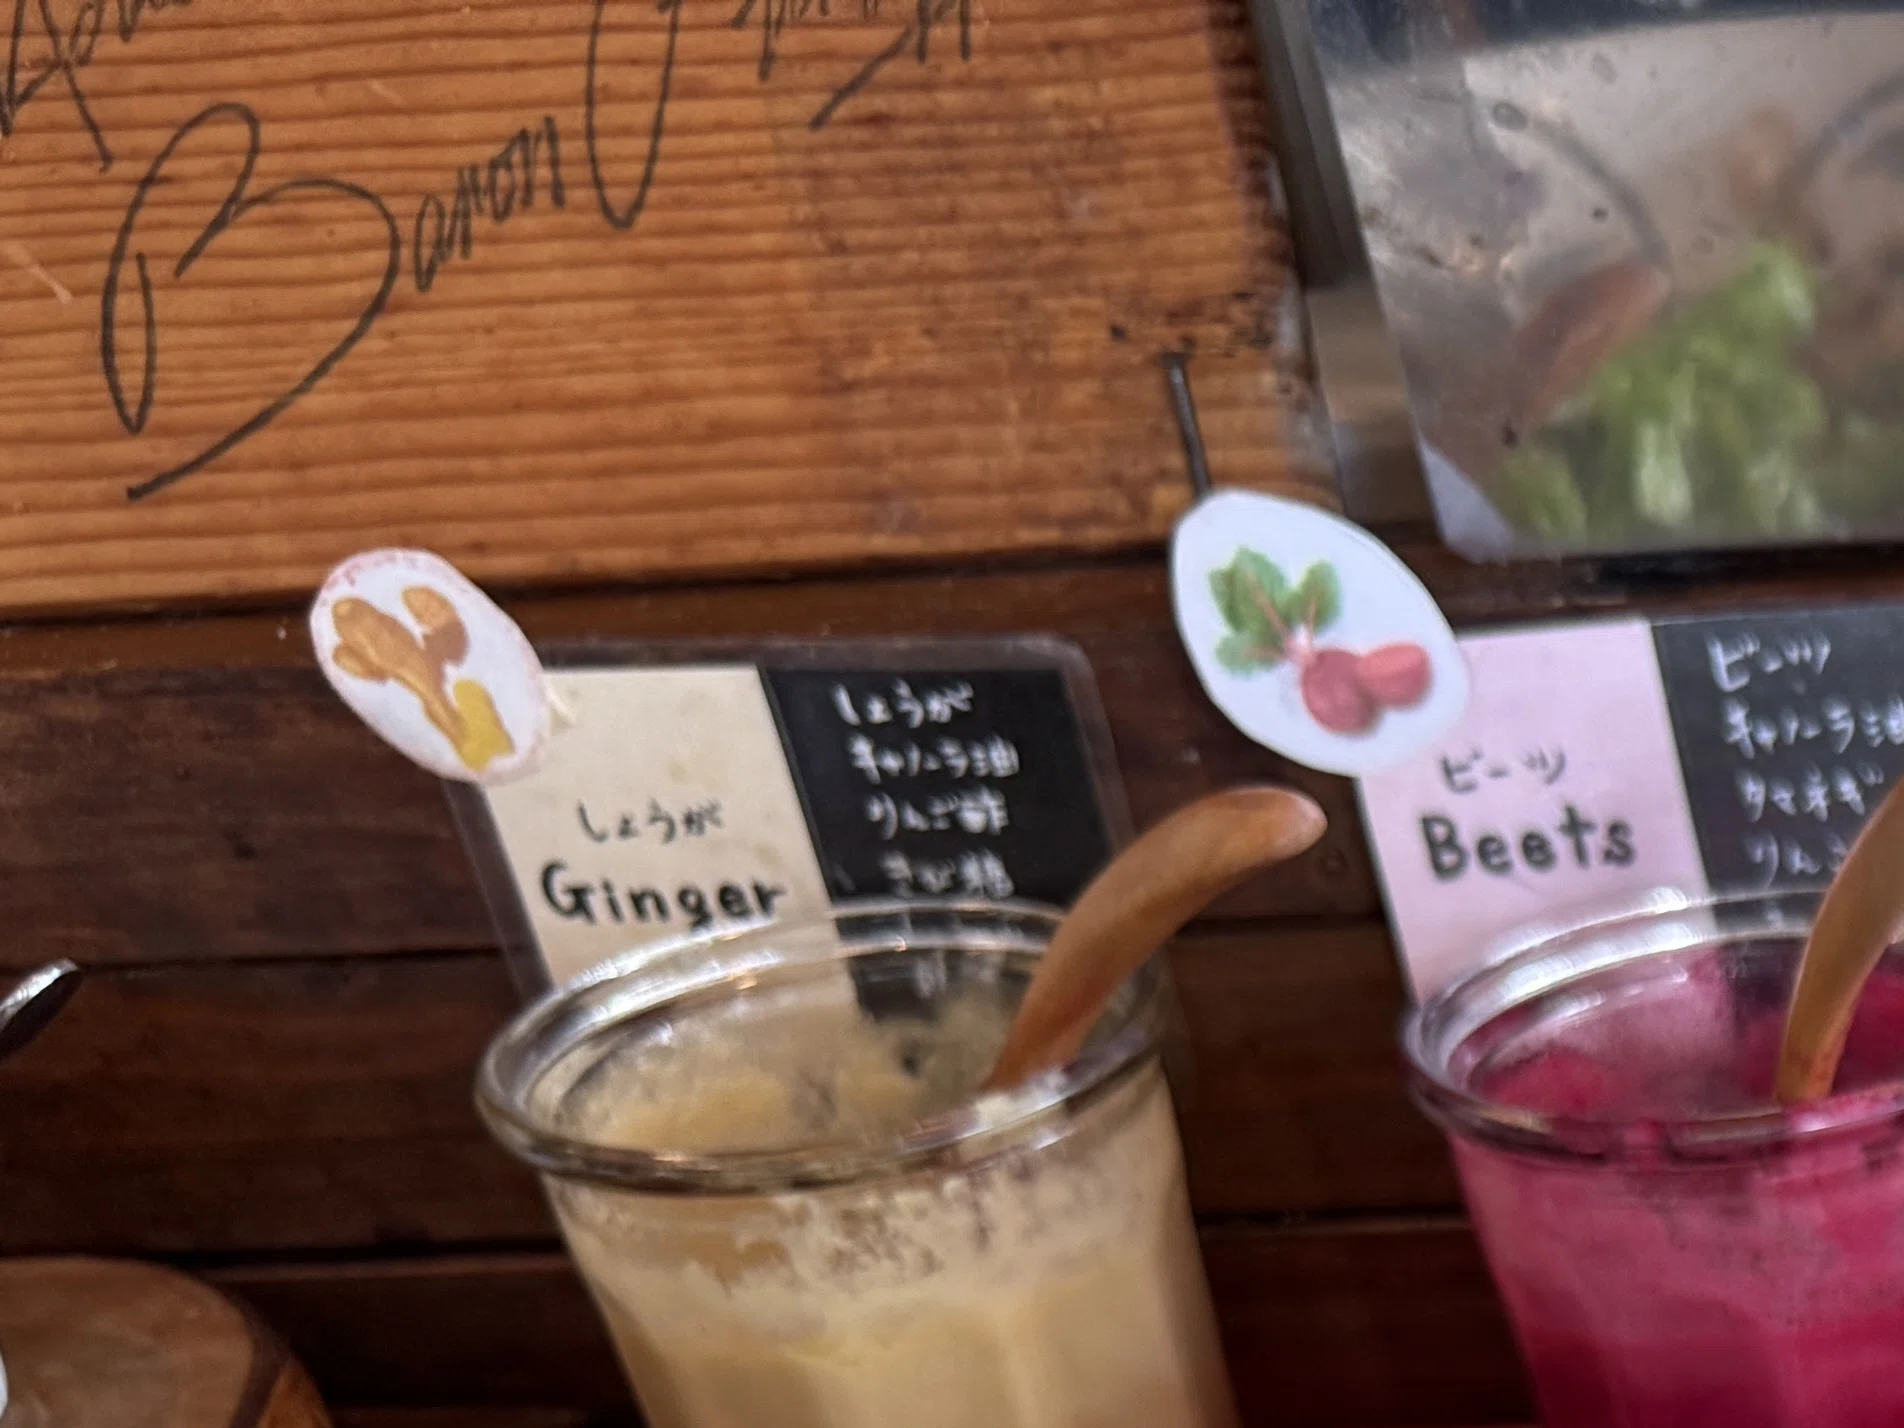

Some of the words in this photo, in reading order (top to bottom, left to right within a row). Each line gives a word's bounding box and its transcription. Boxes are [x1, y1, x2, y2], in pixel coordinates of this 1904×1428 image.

[1708, 630, 1832, 693] ビーツ
[1441, 745, 1568, 795] ビーツ
[577, 797, 724, 845] しょうが
[1420, 798, 1637, 883] Beets
[541, 856, 788, 933] Ginger
